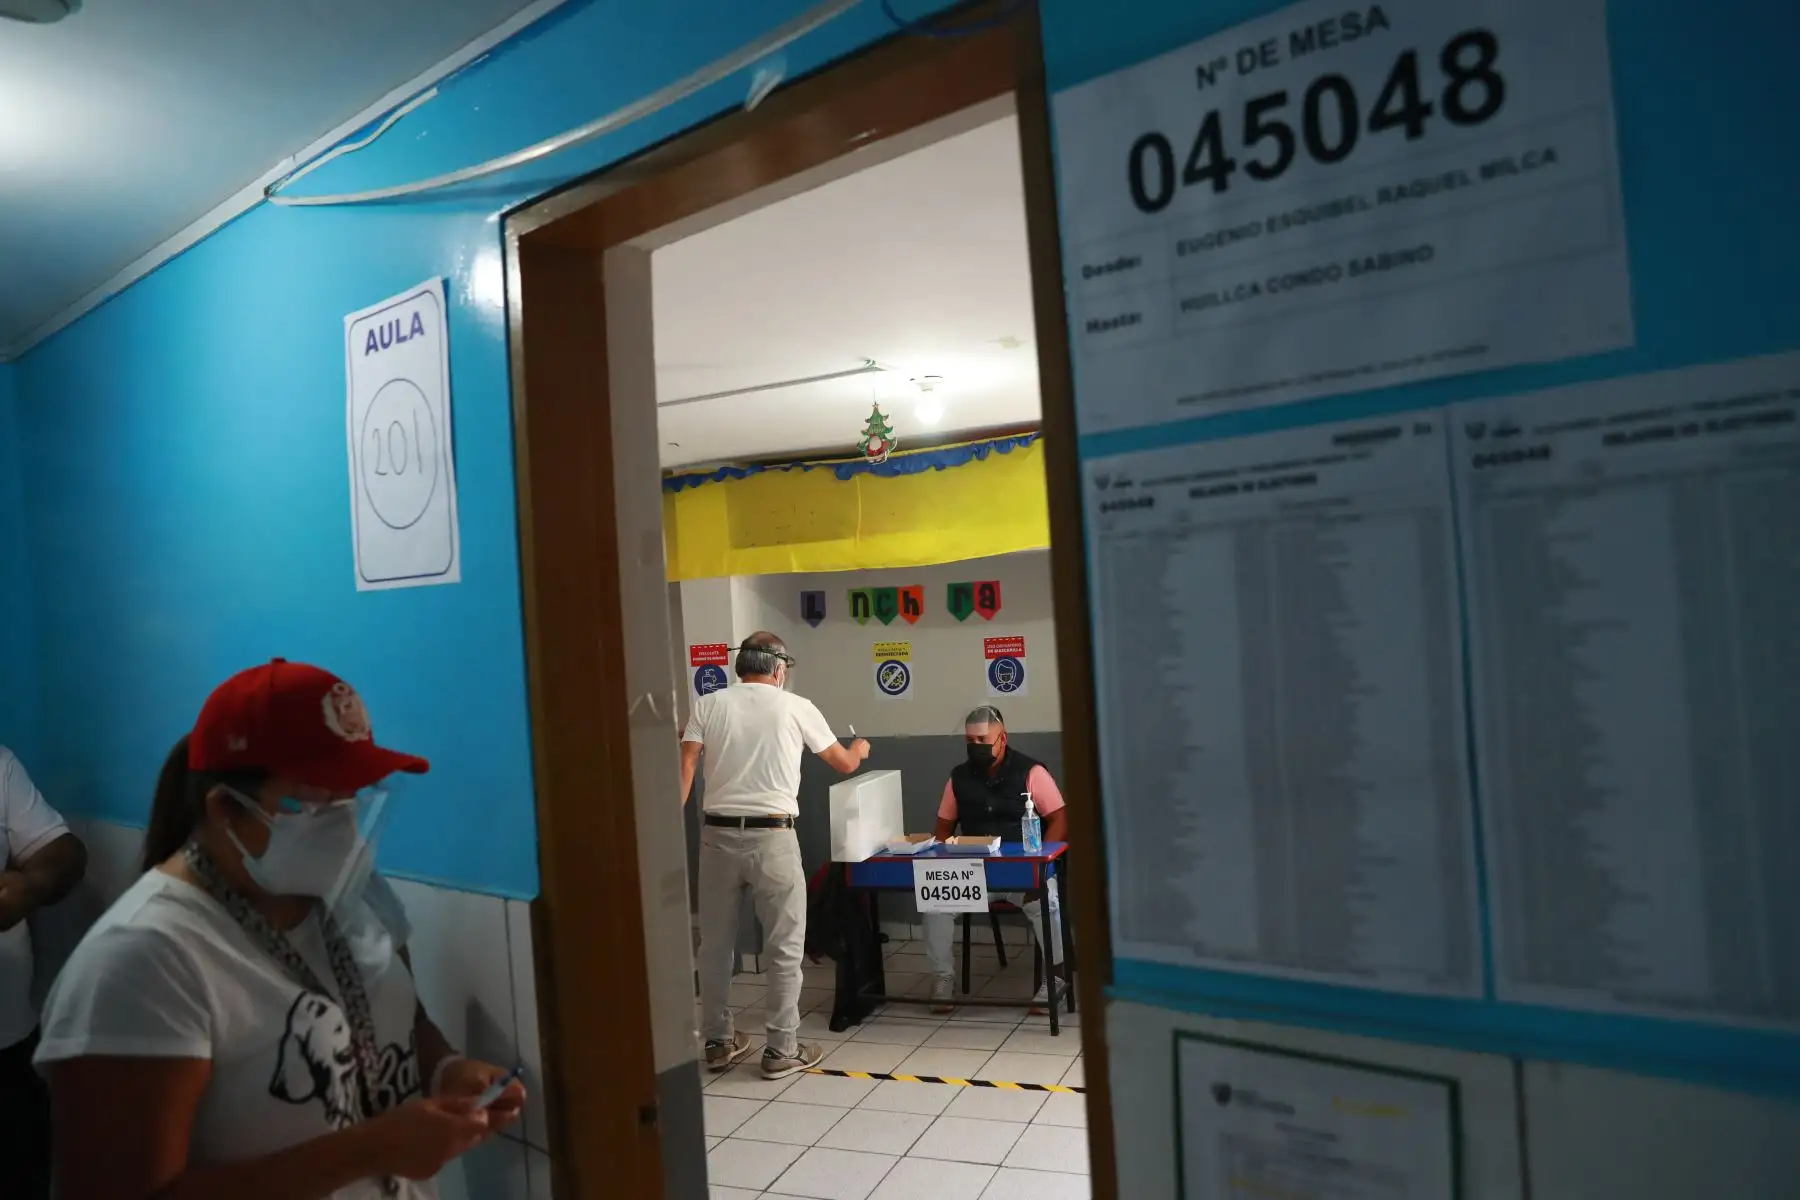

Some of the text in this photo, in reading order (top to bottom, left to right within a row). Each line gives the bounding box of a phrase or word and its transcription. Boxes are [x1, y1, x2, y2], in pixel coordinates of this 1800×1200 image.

[1196, 4, 1391, 91] Nº DE MESA
[1127, 28, 1507, 214] 045048
[1175, 146, 1559, 258] EUGENIO ESQUIBEL RAQUEL MILCA
[1267, 263, 1342, 296] CONDO
[1349, 244, 1435, 279] SABINO
[364, 311, 425, 356] AULA
[372, 408, 422, 476] 201
[920, 885, 982, 901] 045048
[925, 870, 974, 881] MESA Nº
